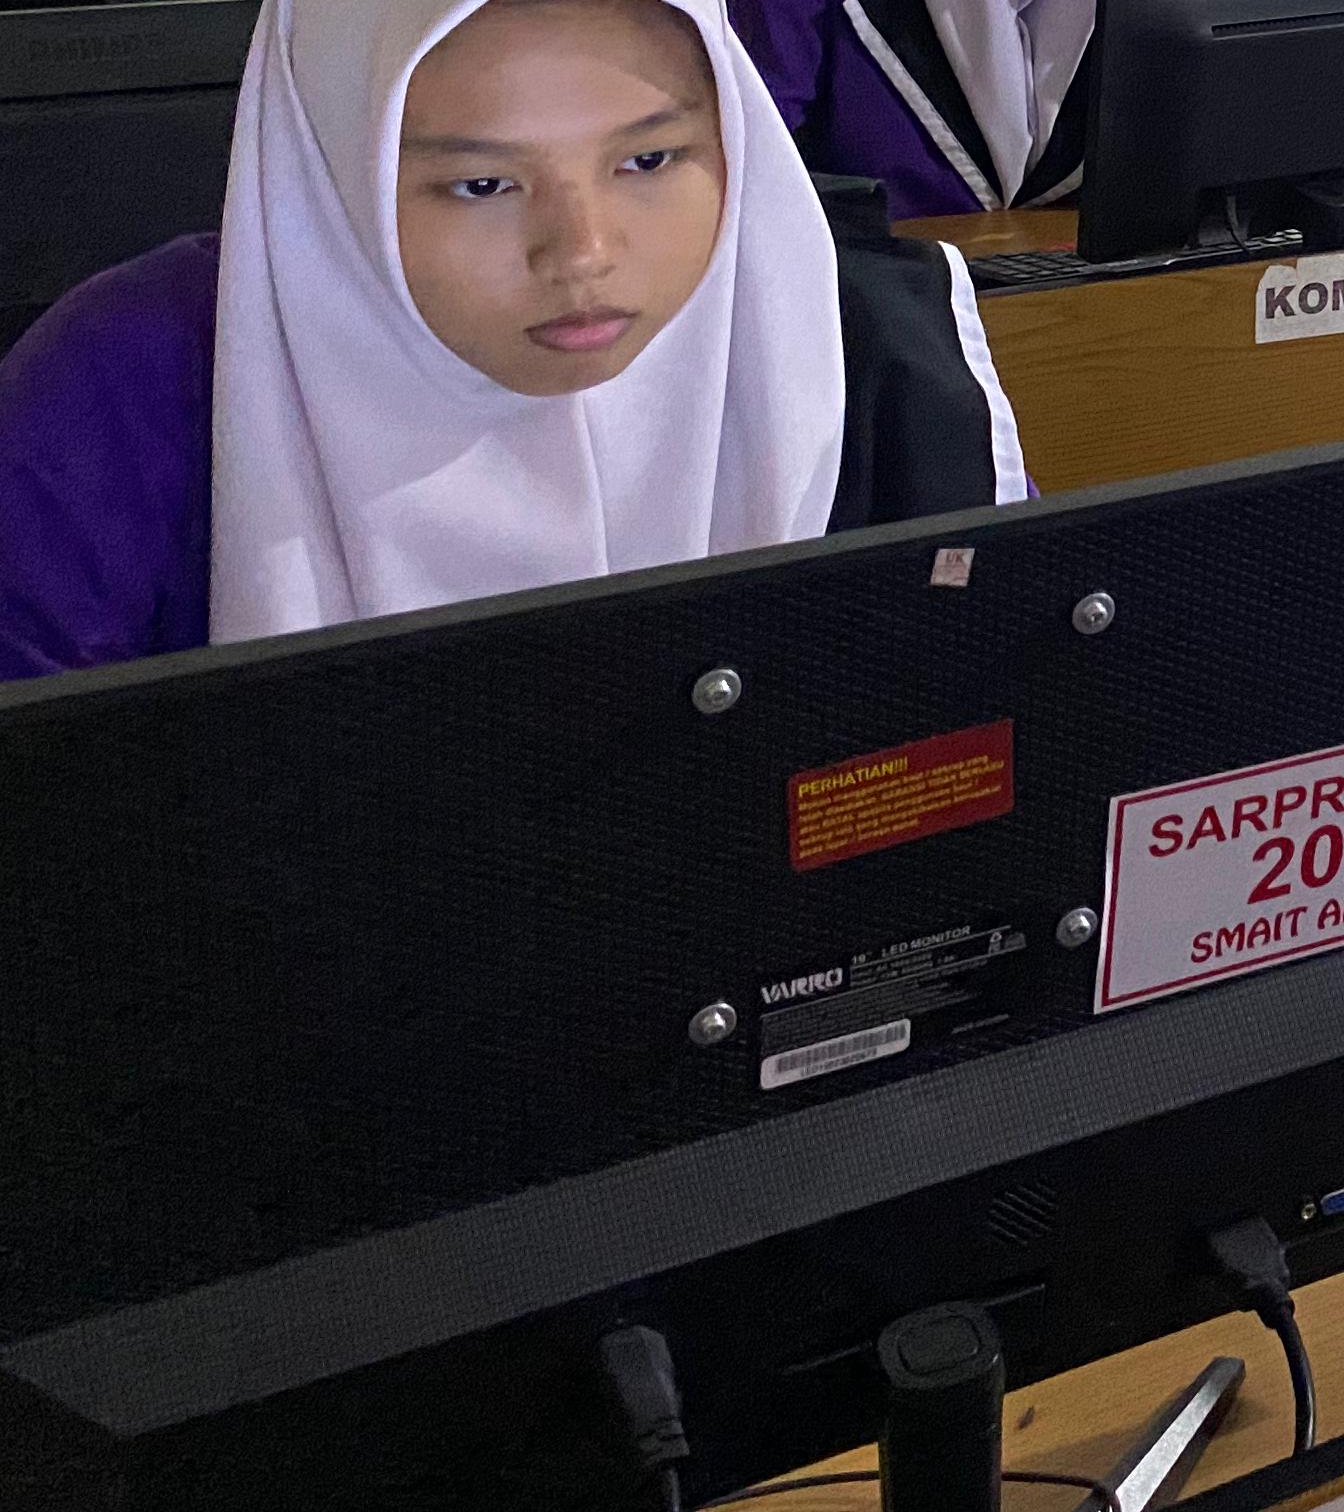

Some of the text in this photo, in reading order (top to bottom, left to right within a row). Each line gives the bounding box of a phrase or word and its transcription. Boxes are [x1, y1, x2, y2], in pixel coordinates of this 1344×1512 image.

[798, 756, 908, 797] PERHATIAN!!!
[881, 942, 908, 958] LED
[1190, 906, 1308, 963] SMAIT
[761, 967, 843, 1004] VARRO
